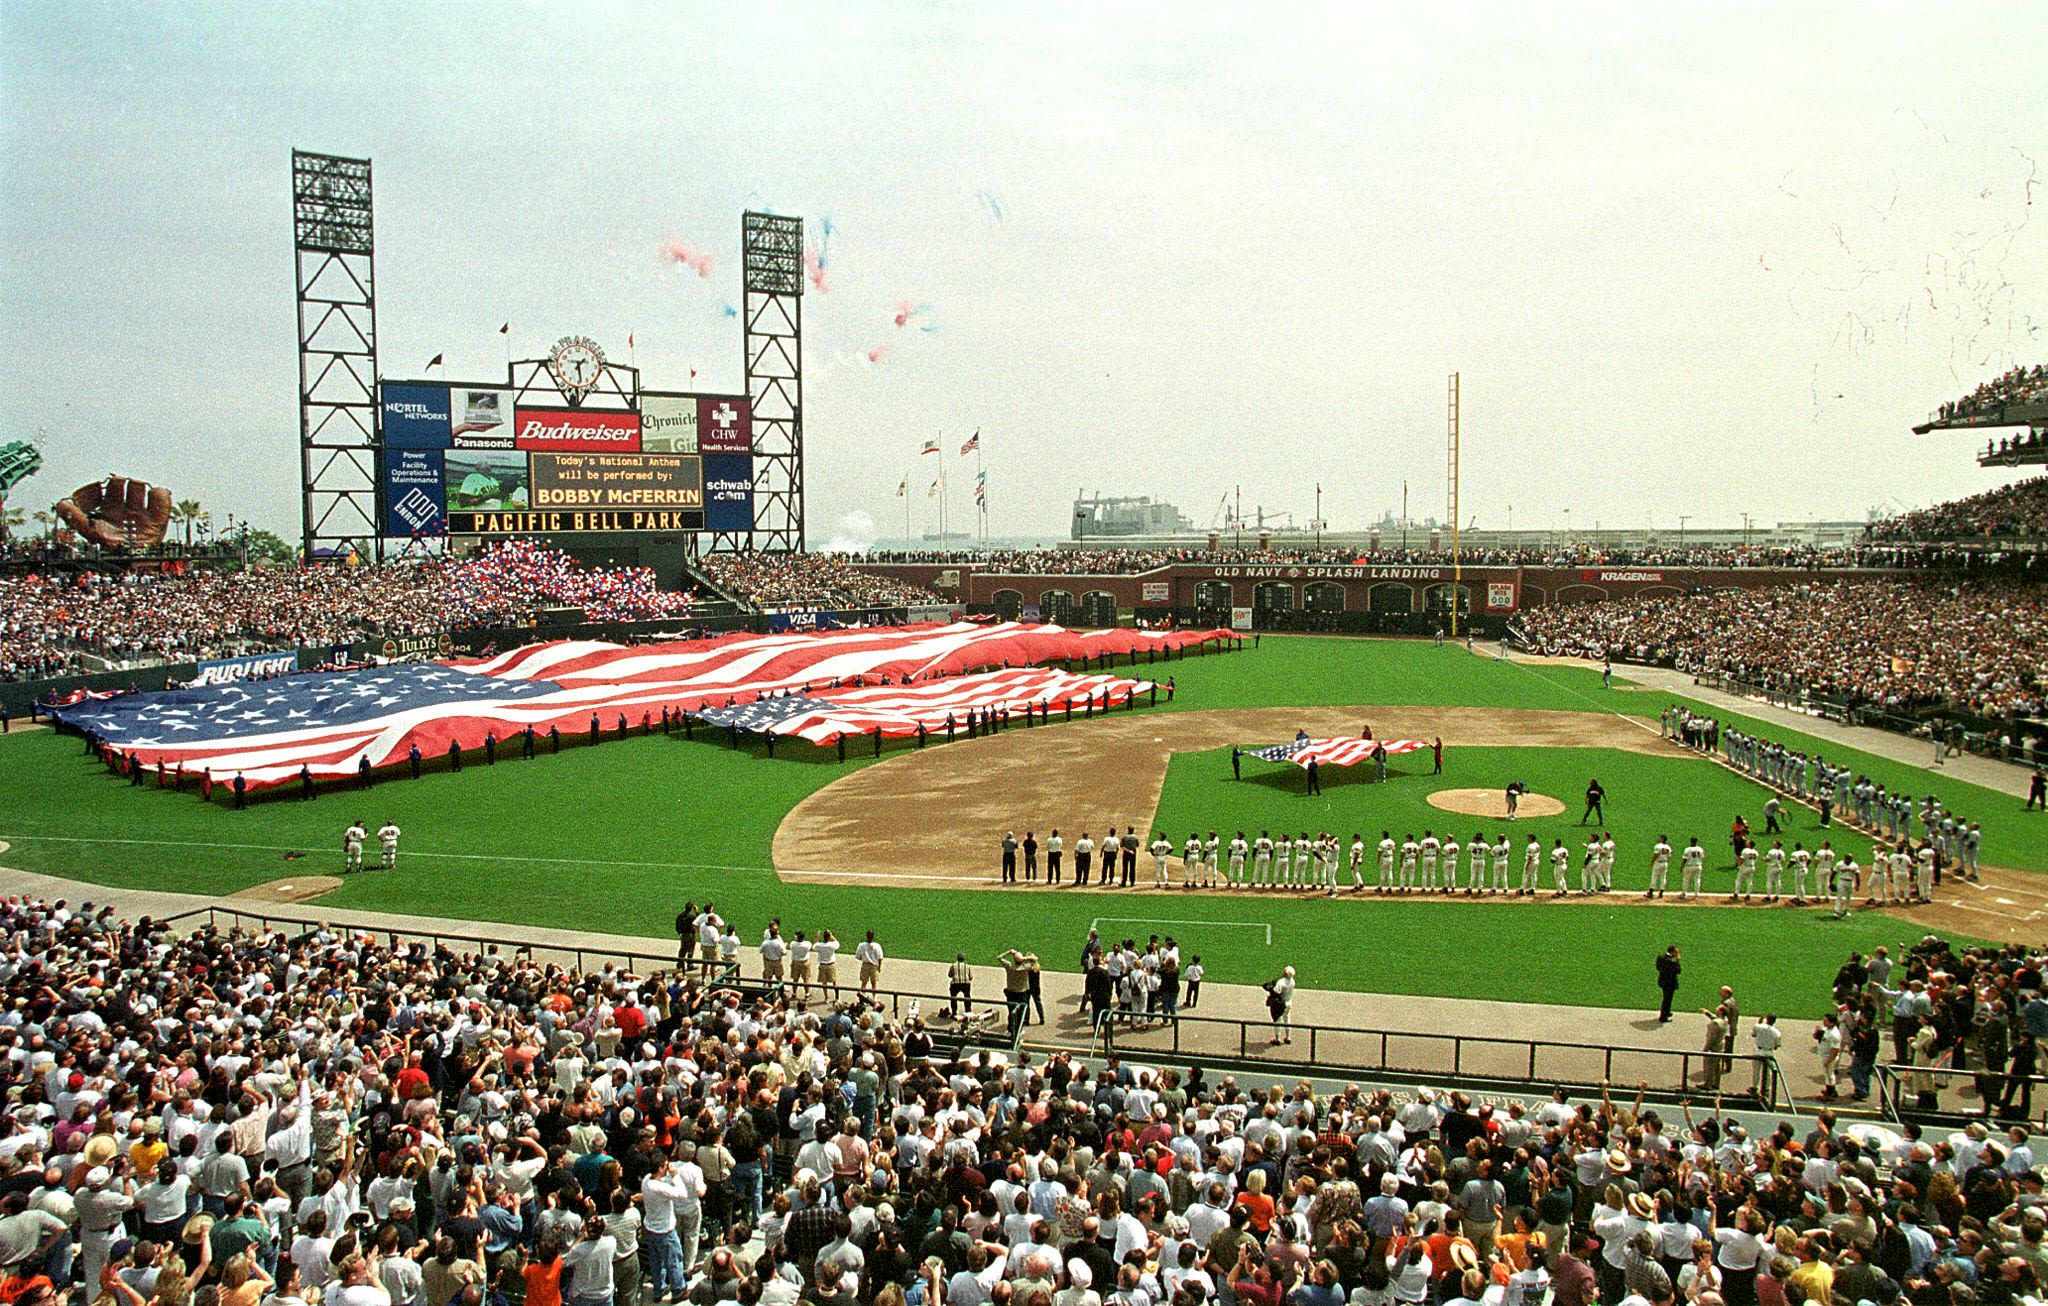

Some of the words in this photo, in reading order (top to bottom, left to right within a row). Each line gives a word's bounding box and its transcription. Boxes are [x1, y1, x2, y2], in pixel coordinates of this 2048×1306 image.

[386, 402, 429, 413] NORTEL
[518, 421, 638, 441] Budweiser
[711, 429, 738, 439] CHW
[454, 439, 514, 448] Panasonic
[702, 443, 723, 451] Health
[402, 462, 428, 470] Facility
[555, 456, 595, 467] Today's
[600, 457, 643, 466] National
[649, 458, 681, 467] Anthem
[391, 469, 431, 477] Operations
[558, 470, 581, 480] will
[587, 470, 599, 480] be
[603, 470, 653, 481] performed
[657, 471, 673, 482] by:
[706, 479, 752, 490] schwab
[538, 489, 602, 503] BOBBY
[608, 489, 699, 503] McFERRIN
[395, 504, 421, 530] ENRON
[474, 513, 560, 531] PACIFIC
[574, 513, 622, 530] BELL
[633, 512, 682, 529] PARK
[1215, 567, 1240, 577] OLD
[1246, 567, 1282, 577] NAVY
[1307, 567, 1363, 578] SPLASH
[1371, 568, 1440, 578] LANDING
[1600, 572, 1646, 581] KRAGEN
[789, 613, 816, 625] VISA
[204, 663, 243, 685] BUD
[242, 657, 295, 678] LIGHT
